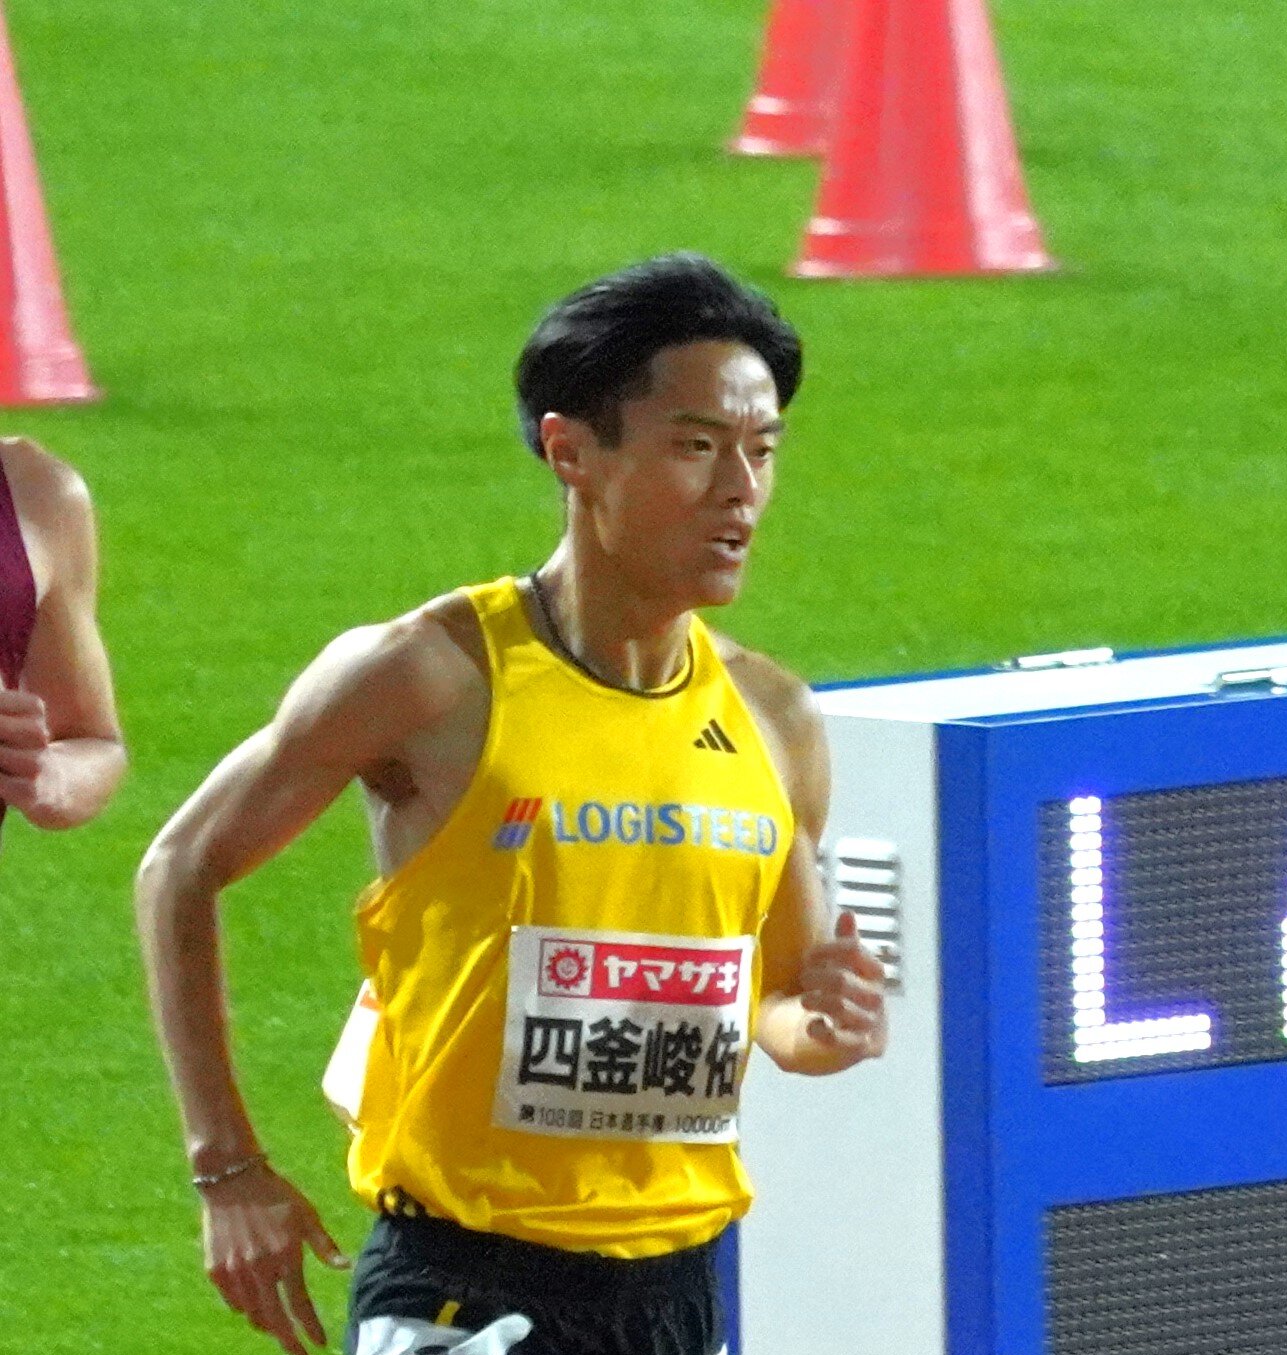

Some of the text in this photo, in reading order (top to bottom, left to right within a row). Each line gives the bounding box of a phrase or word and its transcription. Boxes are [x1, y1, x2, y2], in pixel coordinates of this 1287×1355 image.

[552, 802, 778, 856] LOGISTEED
[517, 1016, 740, 1098] 四釜峻佑
